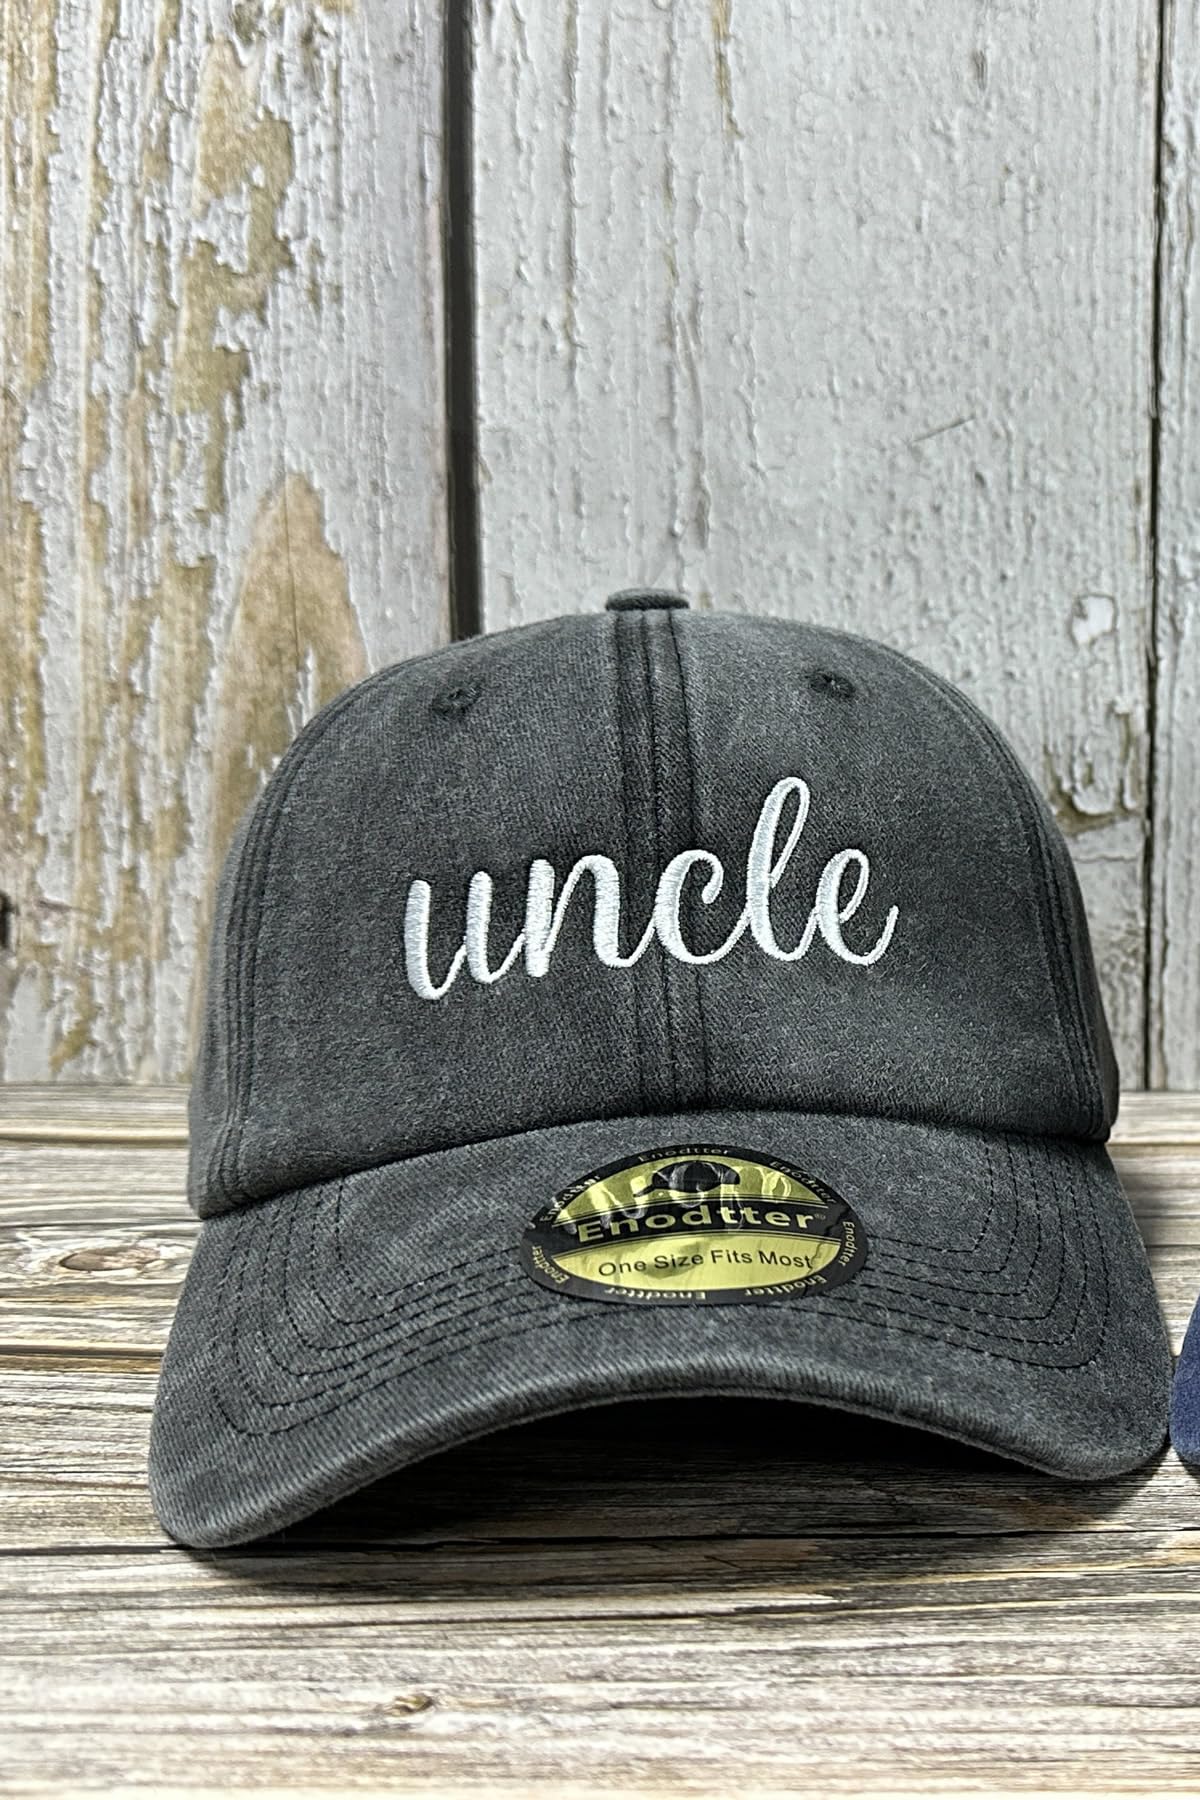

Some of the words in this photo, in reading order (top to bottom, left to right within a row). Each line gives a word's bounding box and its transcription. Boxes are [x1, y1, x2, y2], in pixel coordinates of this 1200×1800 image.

[404, 777, 898, 999] uncle
[577, 1205, 815, 1243] Enodtter
[598, 1261, 647, 1277] One
[653, 1252, 704, 1270] Size
[711, 1249, 753, 1265] Fits
[760, 1250, 813, 1269] Most
